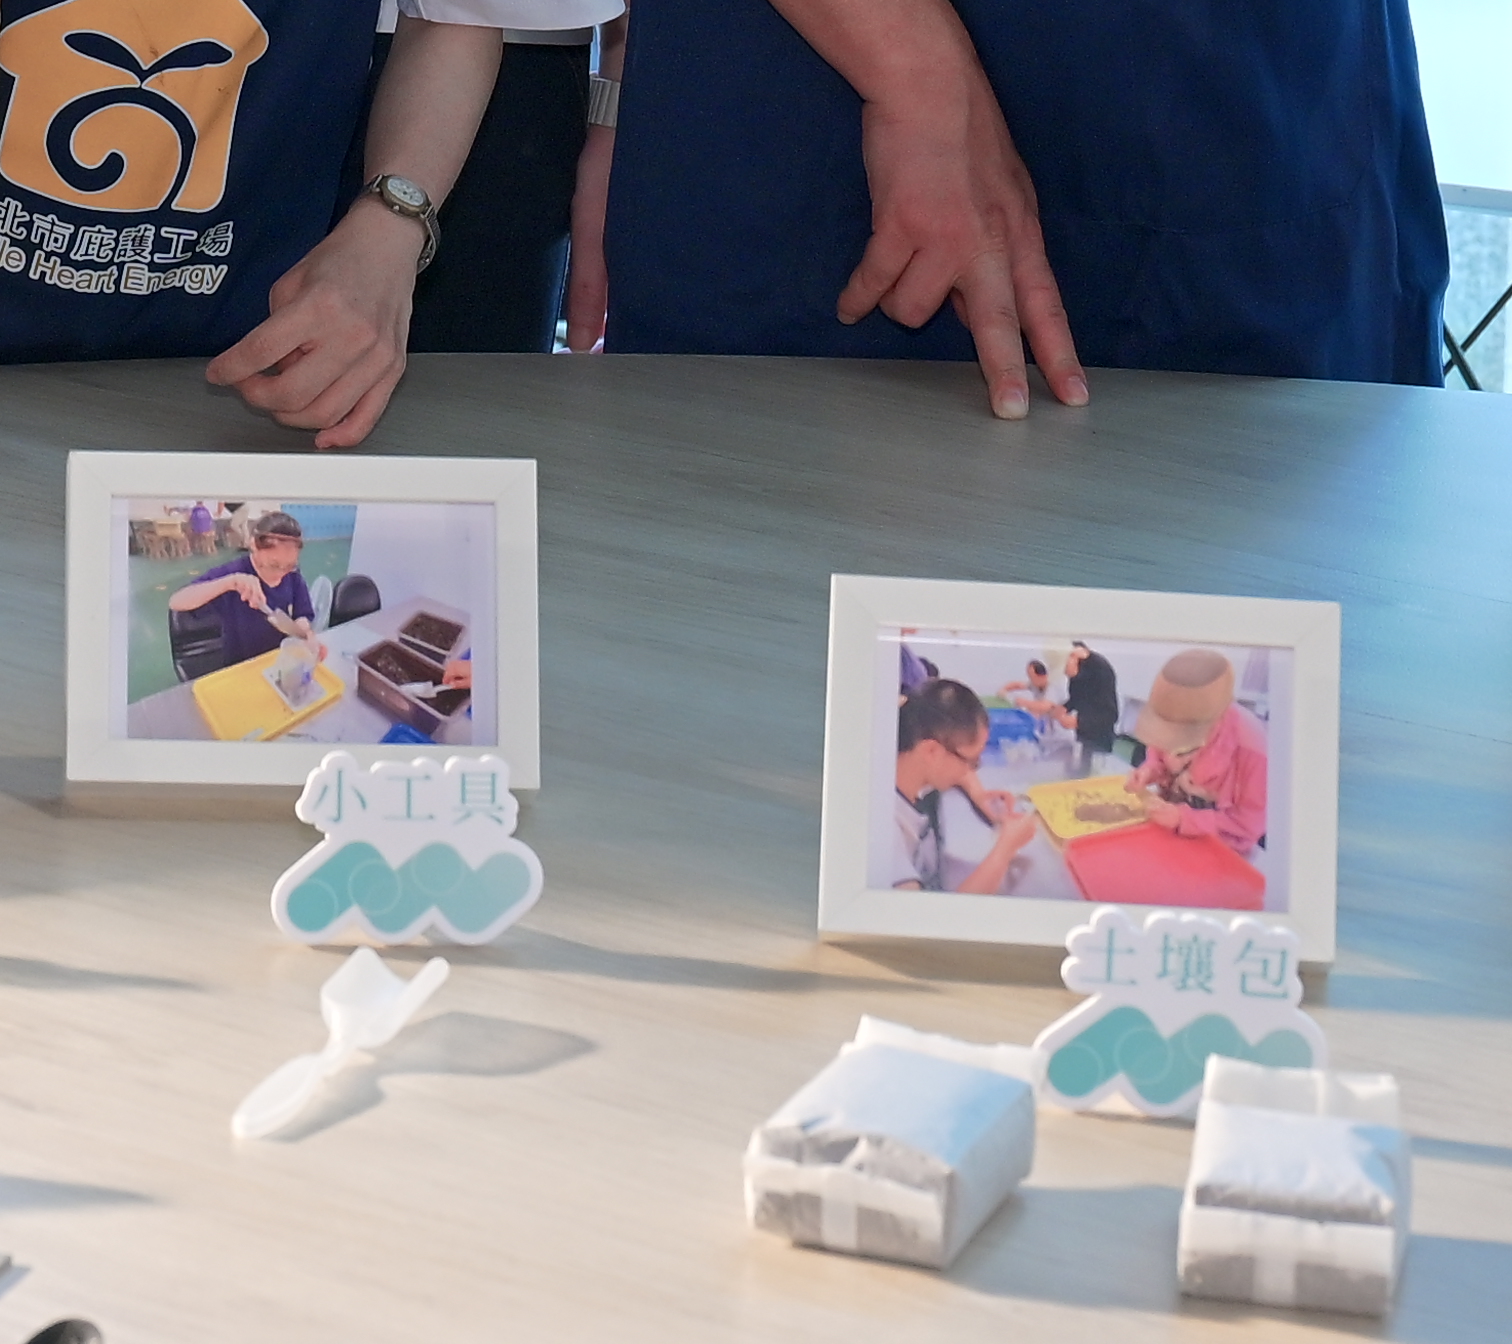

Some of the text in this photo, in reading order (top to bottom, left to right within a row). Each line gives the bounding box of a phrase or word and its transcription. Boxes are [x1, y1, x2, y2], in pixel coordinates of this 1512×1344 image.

[29, 251, 117, 294] Heart
[120, 264, 229, 295] Energy
[313, 766, 506, 826] 小工具
[1078, 929, 1292, 1002] 土壤包
